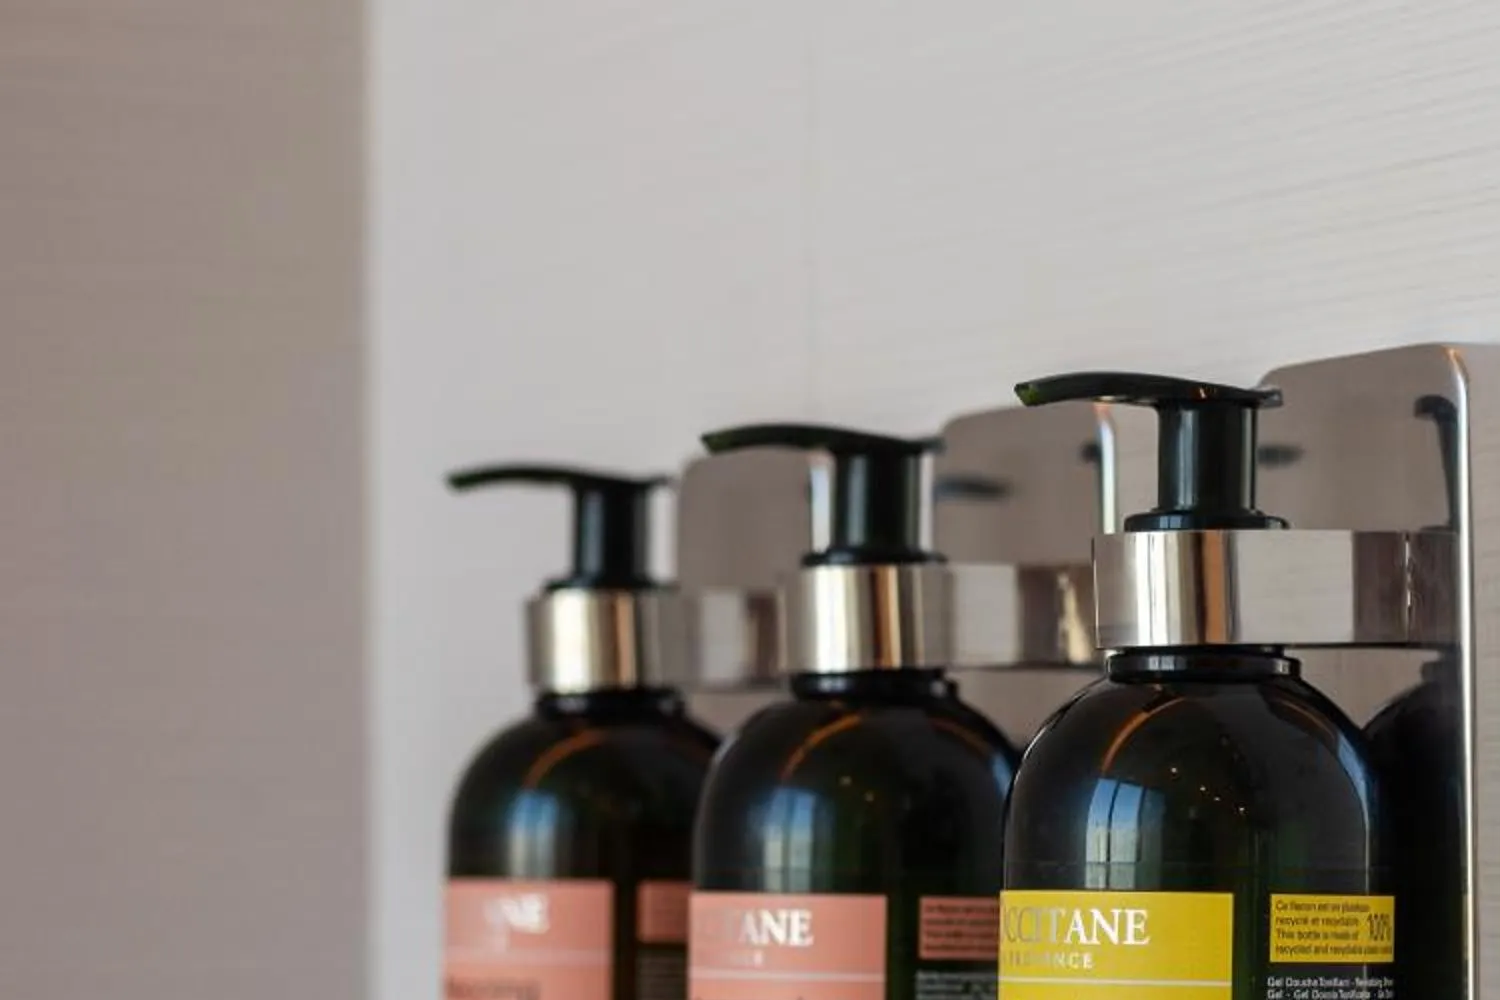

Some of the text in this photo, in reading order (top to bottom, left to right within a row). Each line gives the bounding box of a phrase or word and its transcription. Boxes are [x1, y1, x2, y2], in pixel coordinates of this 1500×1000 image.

[1267, 976, 1283, 987] Gel
[1286, 977, 1318, 987] Douche
[1267, 989, 1283, 999] Gel
